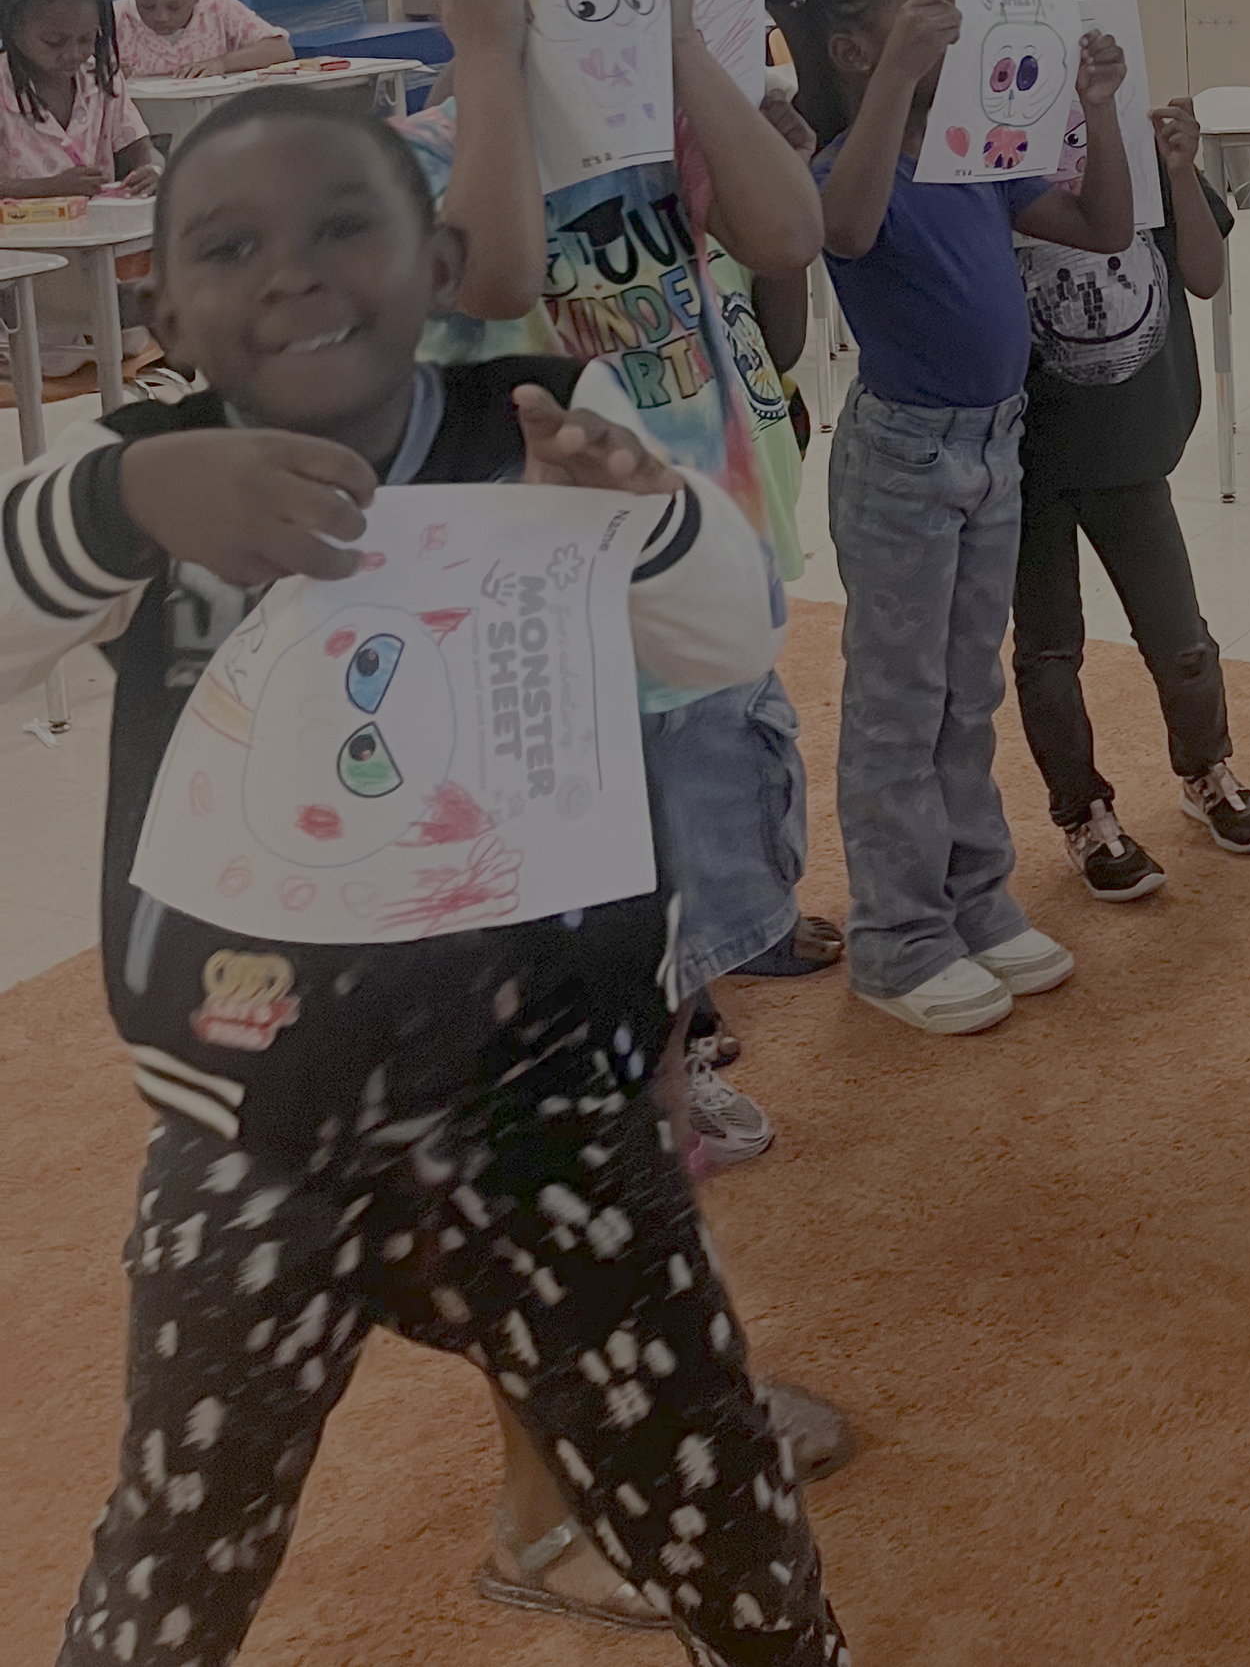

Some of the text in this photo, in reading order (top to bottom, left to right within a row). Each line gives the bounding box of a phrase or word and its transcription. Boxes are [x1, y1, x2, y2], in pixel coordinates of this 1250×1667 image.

[599, 509, 630, 553] Name
[470, 606, 482, 656] Create
[471, 658, 484, 693] your
[487, 620, 522, 760] SHEET
[517, 575, 558, 801] MONSTER
[476, 694, 486, 727] own
